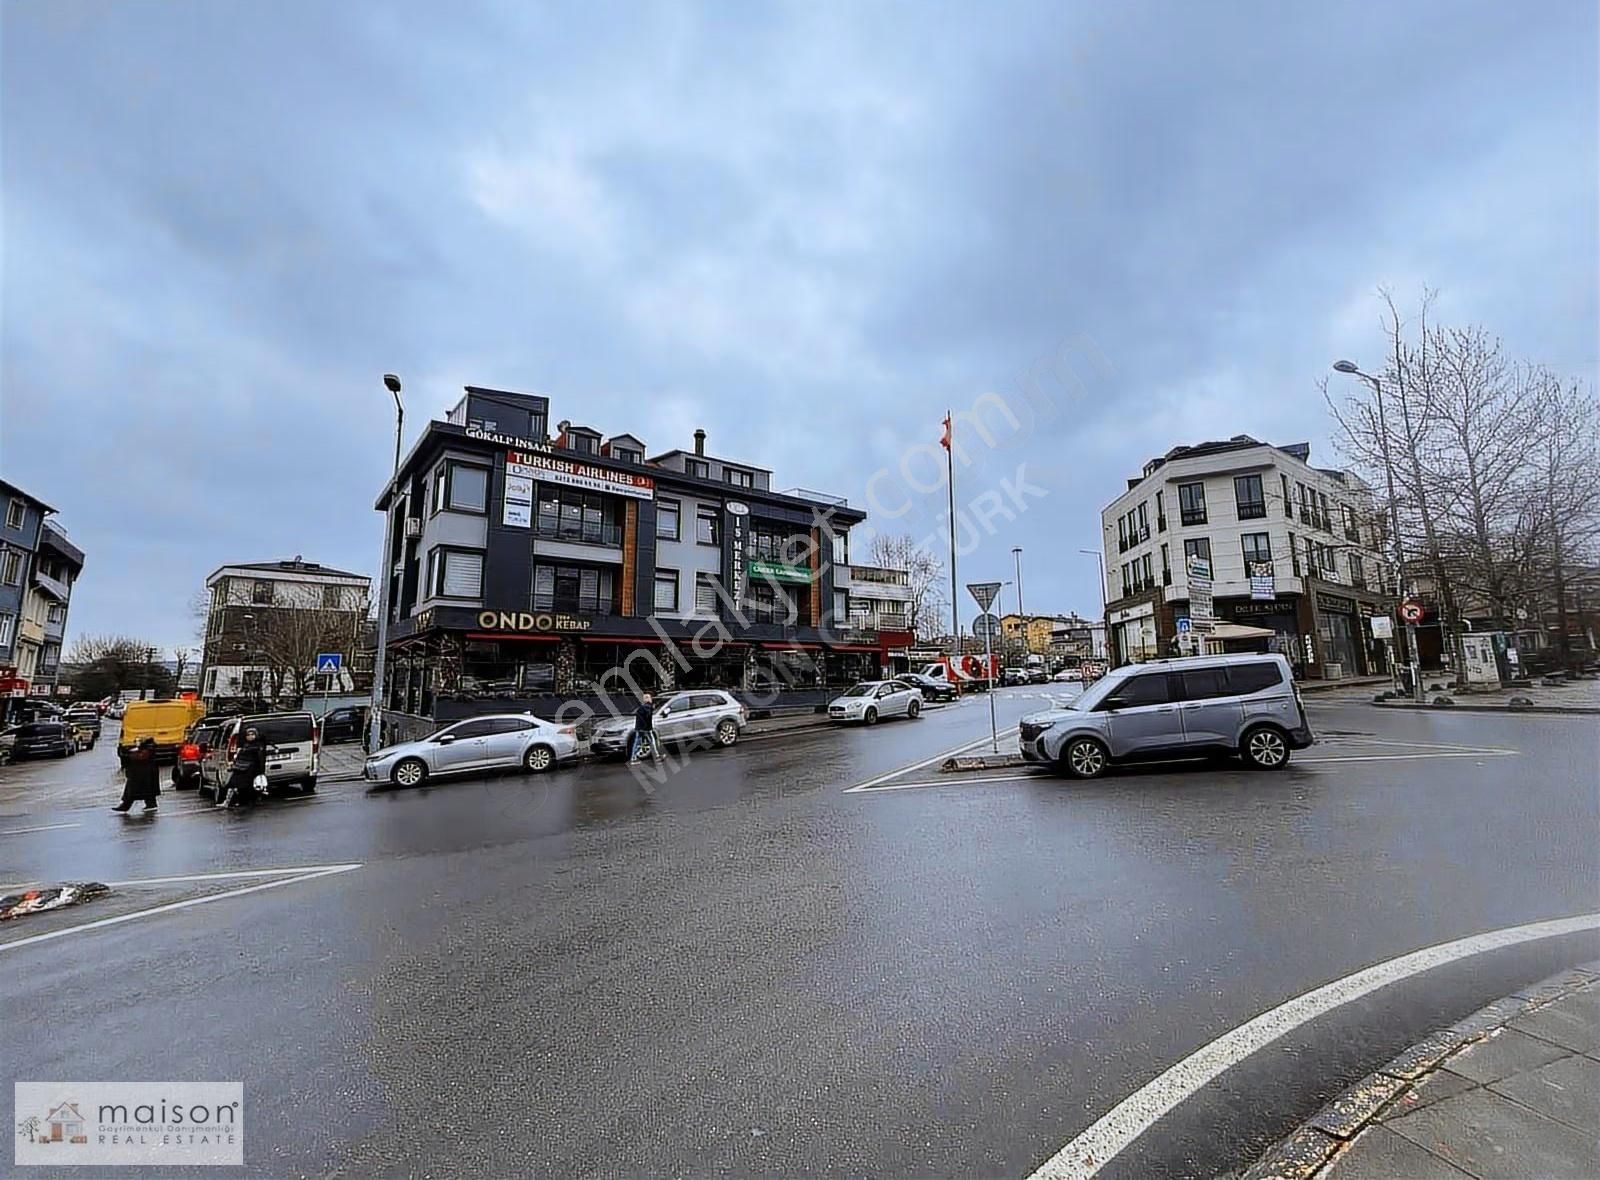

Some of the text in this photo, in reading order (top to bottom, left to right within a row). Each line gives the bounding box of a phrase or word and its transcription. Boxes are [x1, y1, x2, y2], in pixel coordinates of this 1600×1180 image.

[513, 452, 574, 473] TURKISH
[577, 465, 633, 485] AIRLINES
[478, 611, 553, 631] ONDO
